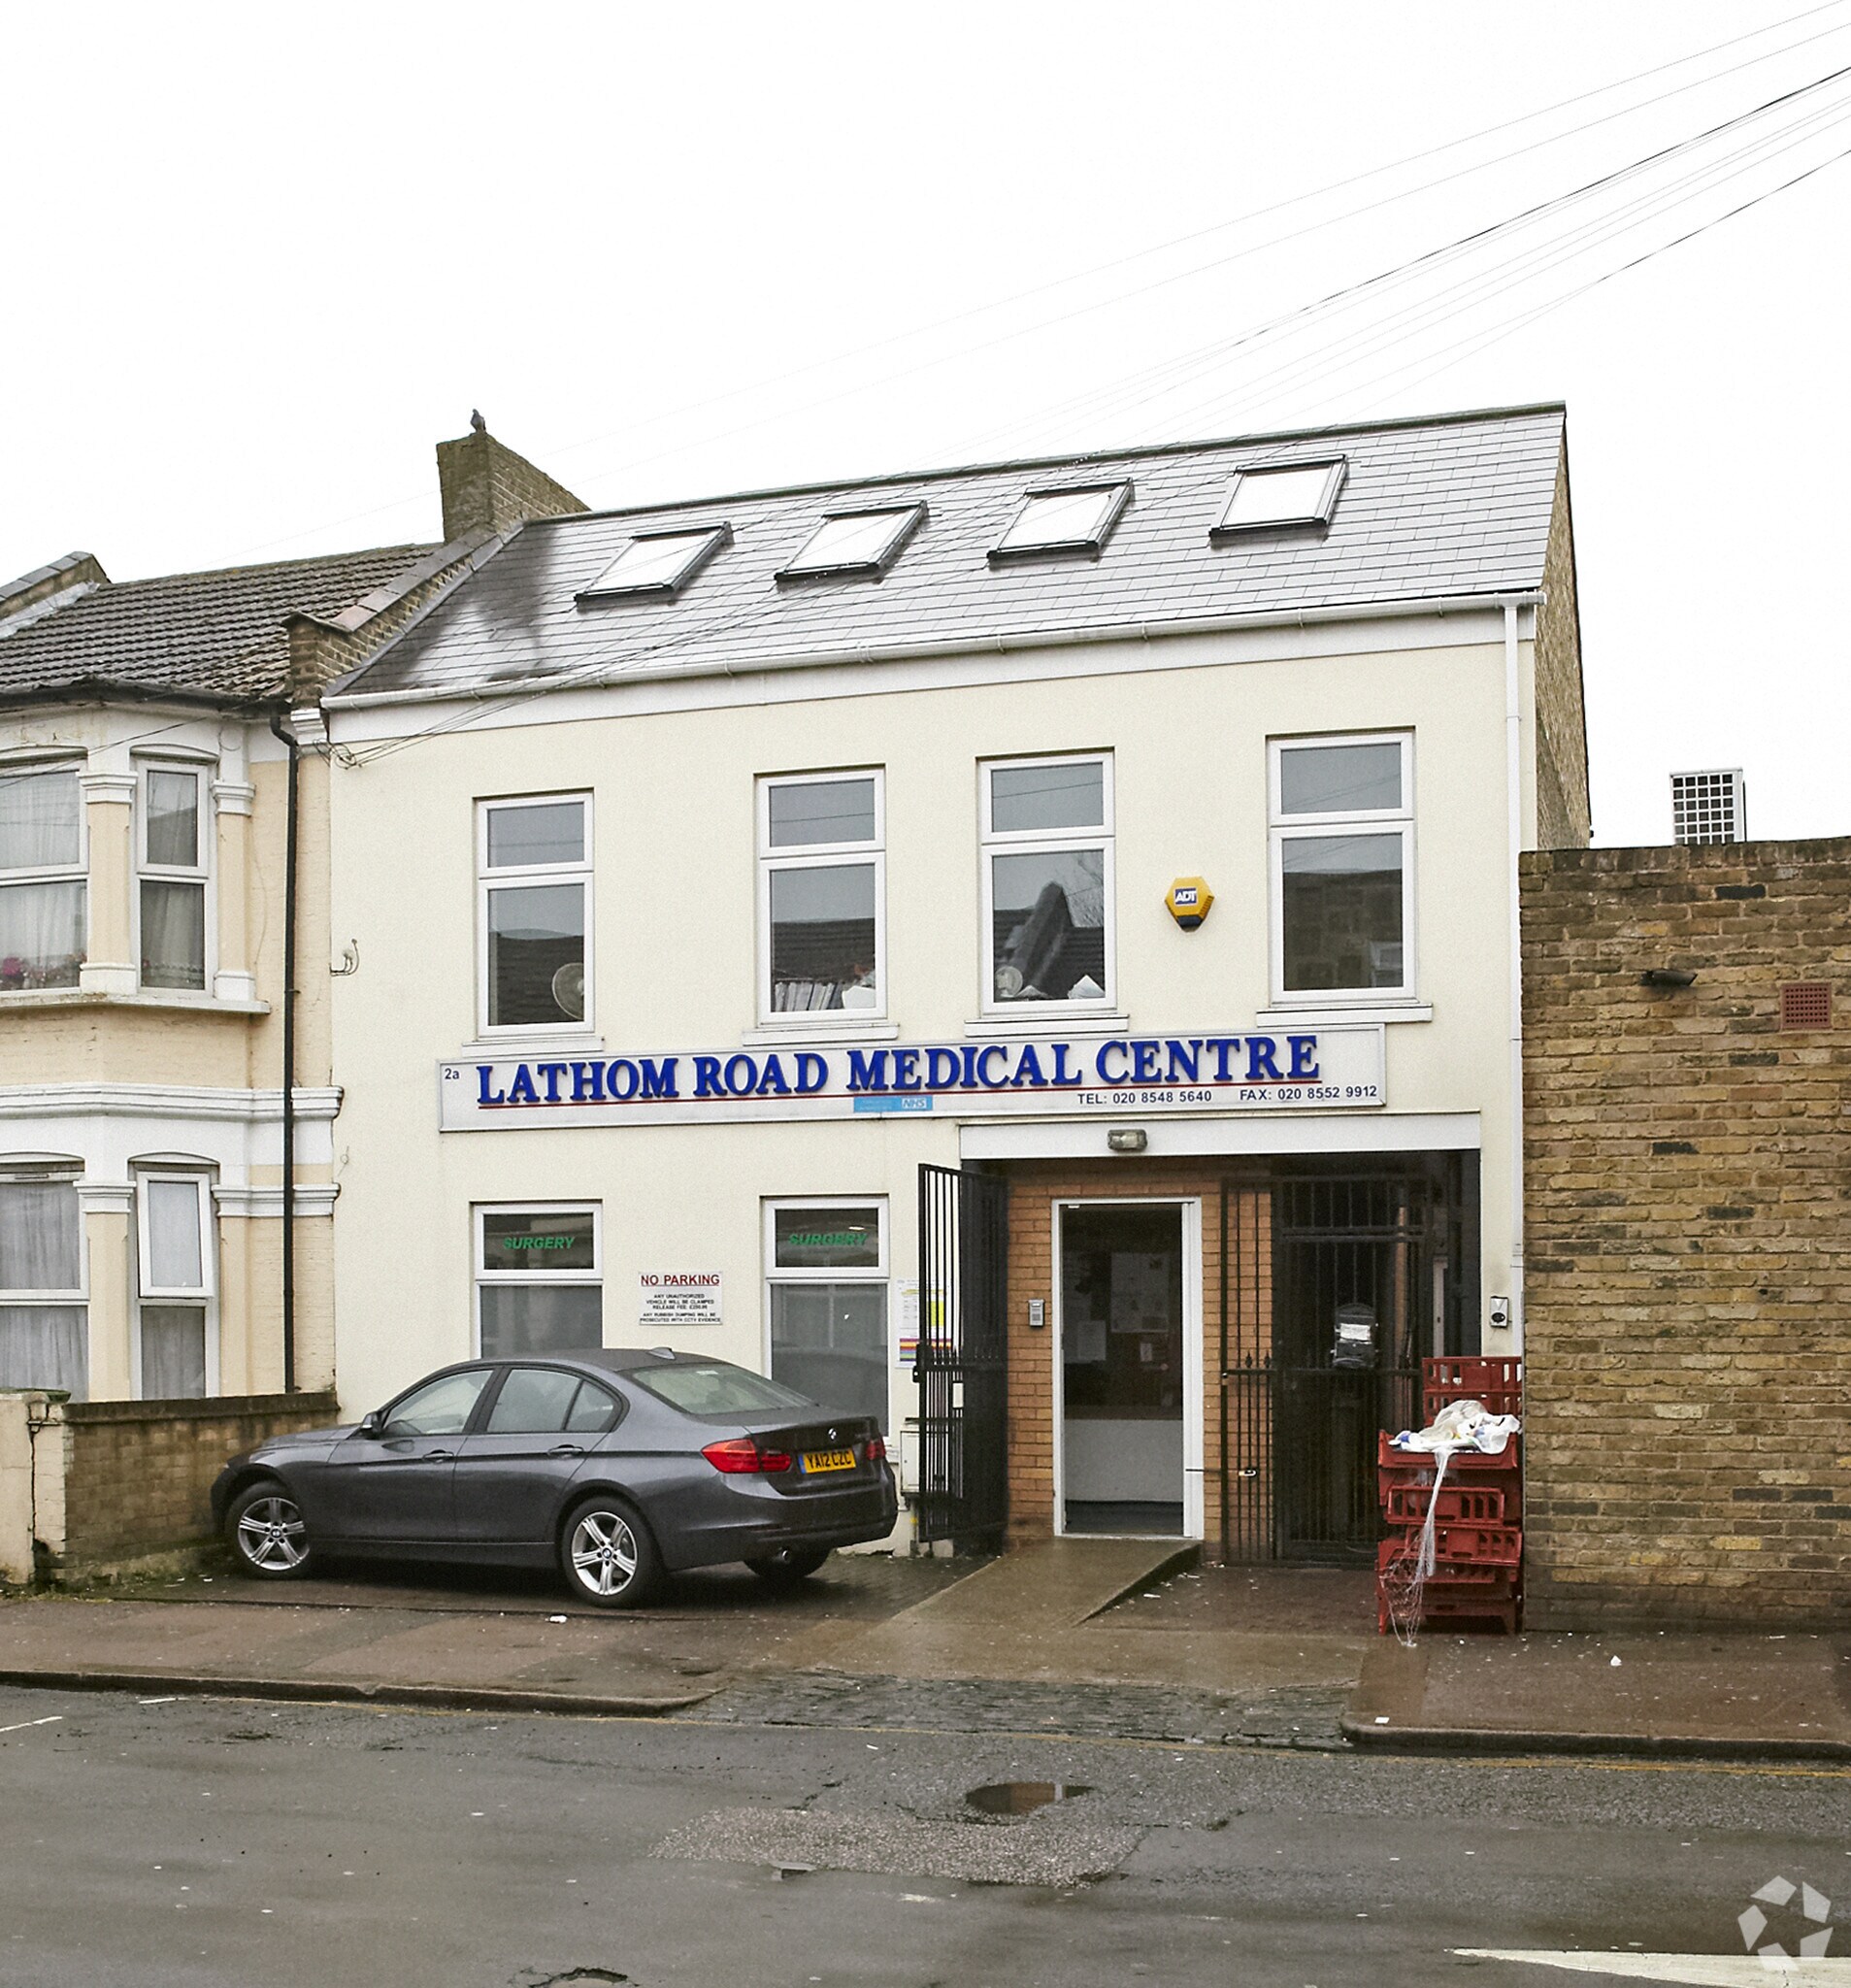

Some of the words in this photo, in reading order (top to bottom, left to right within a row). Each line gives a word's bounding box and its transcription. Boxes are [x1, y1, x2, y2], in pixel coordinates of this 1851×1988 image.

[1174, 890, 1197, 903] ADT
[444, 1068, 460, 1080] 2a
[476, 1058, 680, 1104] LATHOM
[692, 1052, 829, 1097] ROAD
[846, 1044, 1083, 1091] MEDICAL
[1095, 1035, 1320, 1085] CENTRE
[1077, 1094, 1107, 1105] TEL:
[1112, 1092, 1136, 1104] 020
[1140, 1091, 1174, 1103] 8548
[1179, 1090, 1212, 1102] 5640
[1240, 1089, 1273, 1101] FAX:
[1277, 1088, 1303, 1100] 020
[1306, 1087, 1340, 1099] 8552
[1345, 1085, 1377, 1098] 9912
[903, 1098, 927, 1109] NHS
[503, 1236, 575, 1250] SURGERY
[788, 1233, 868, 1245] SURGERY
[641, 1275, 659, 1286] NO
[664, 1274, 720, 1286] PARKING
[806, 1452, 831, 1469] YA12
[831, 1450, 851, 1466] CZC
